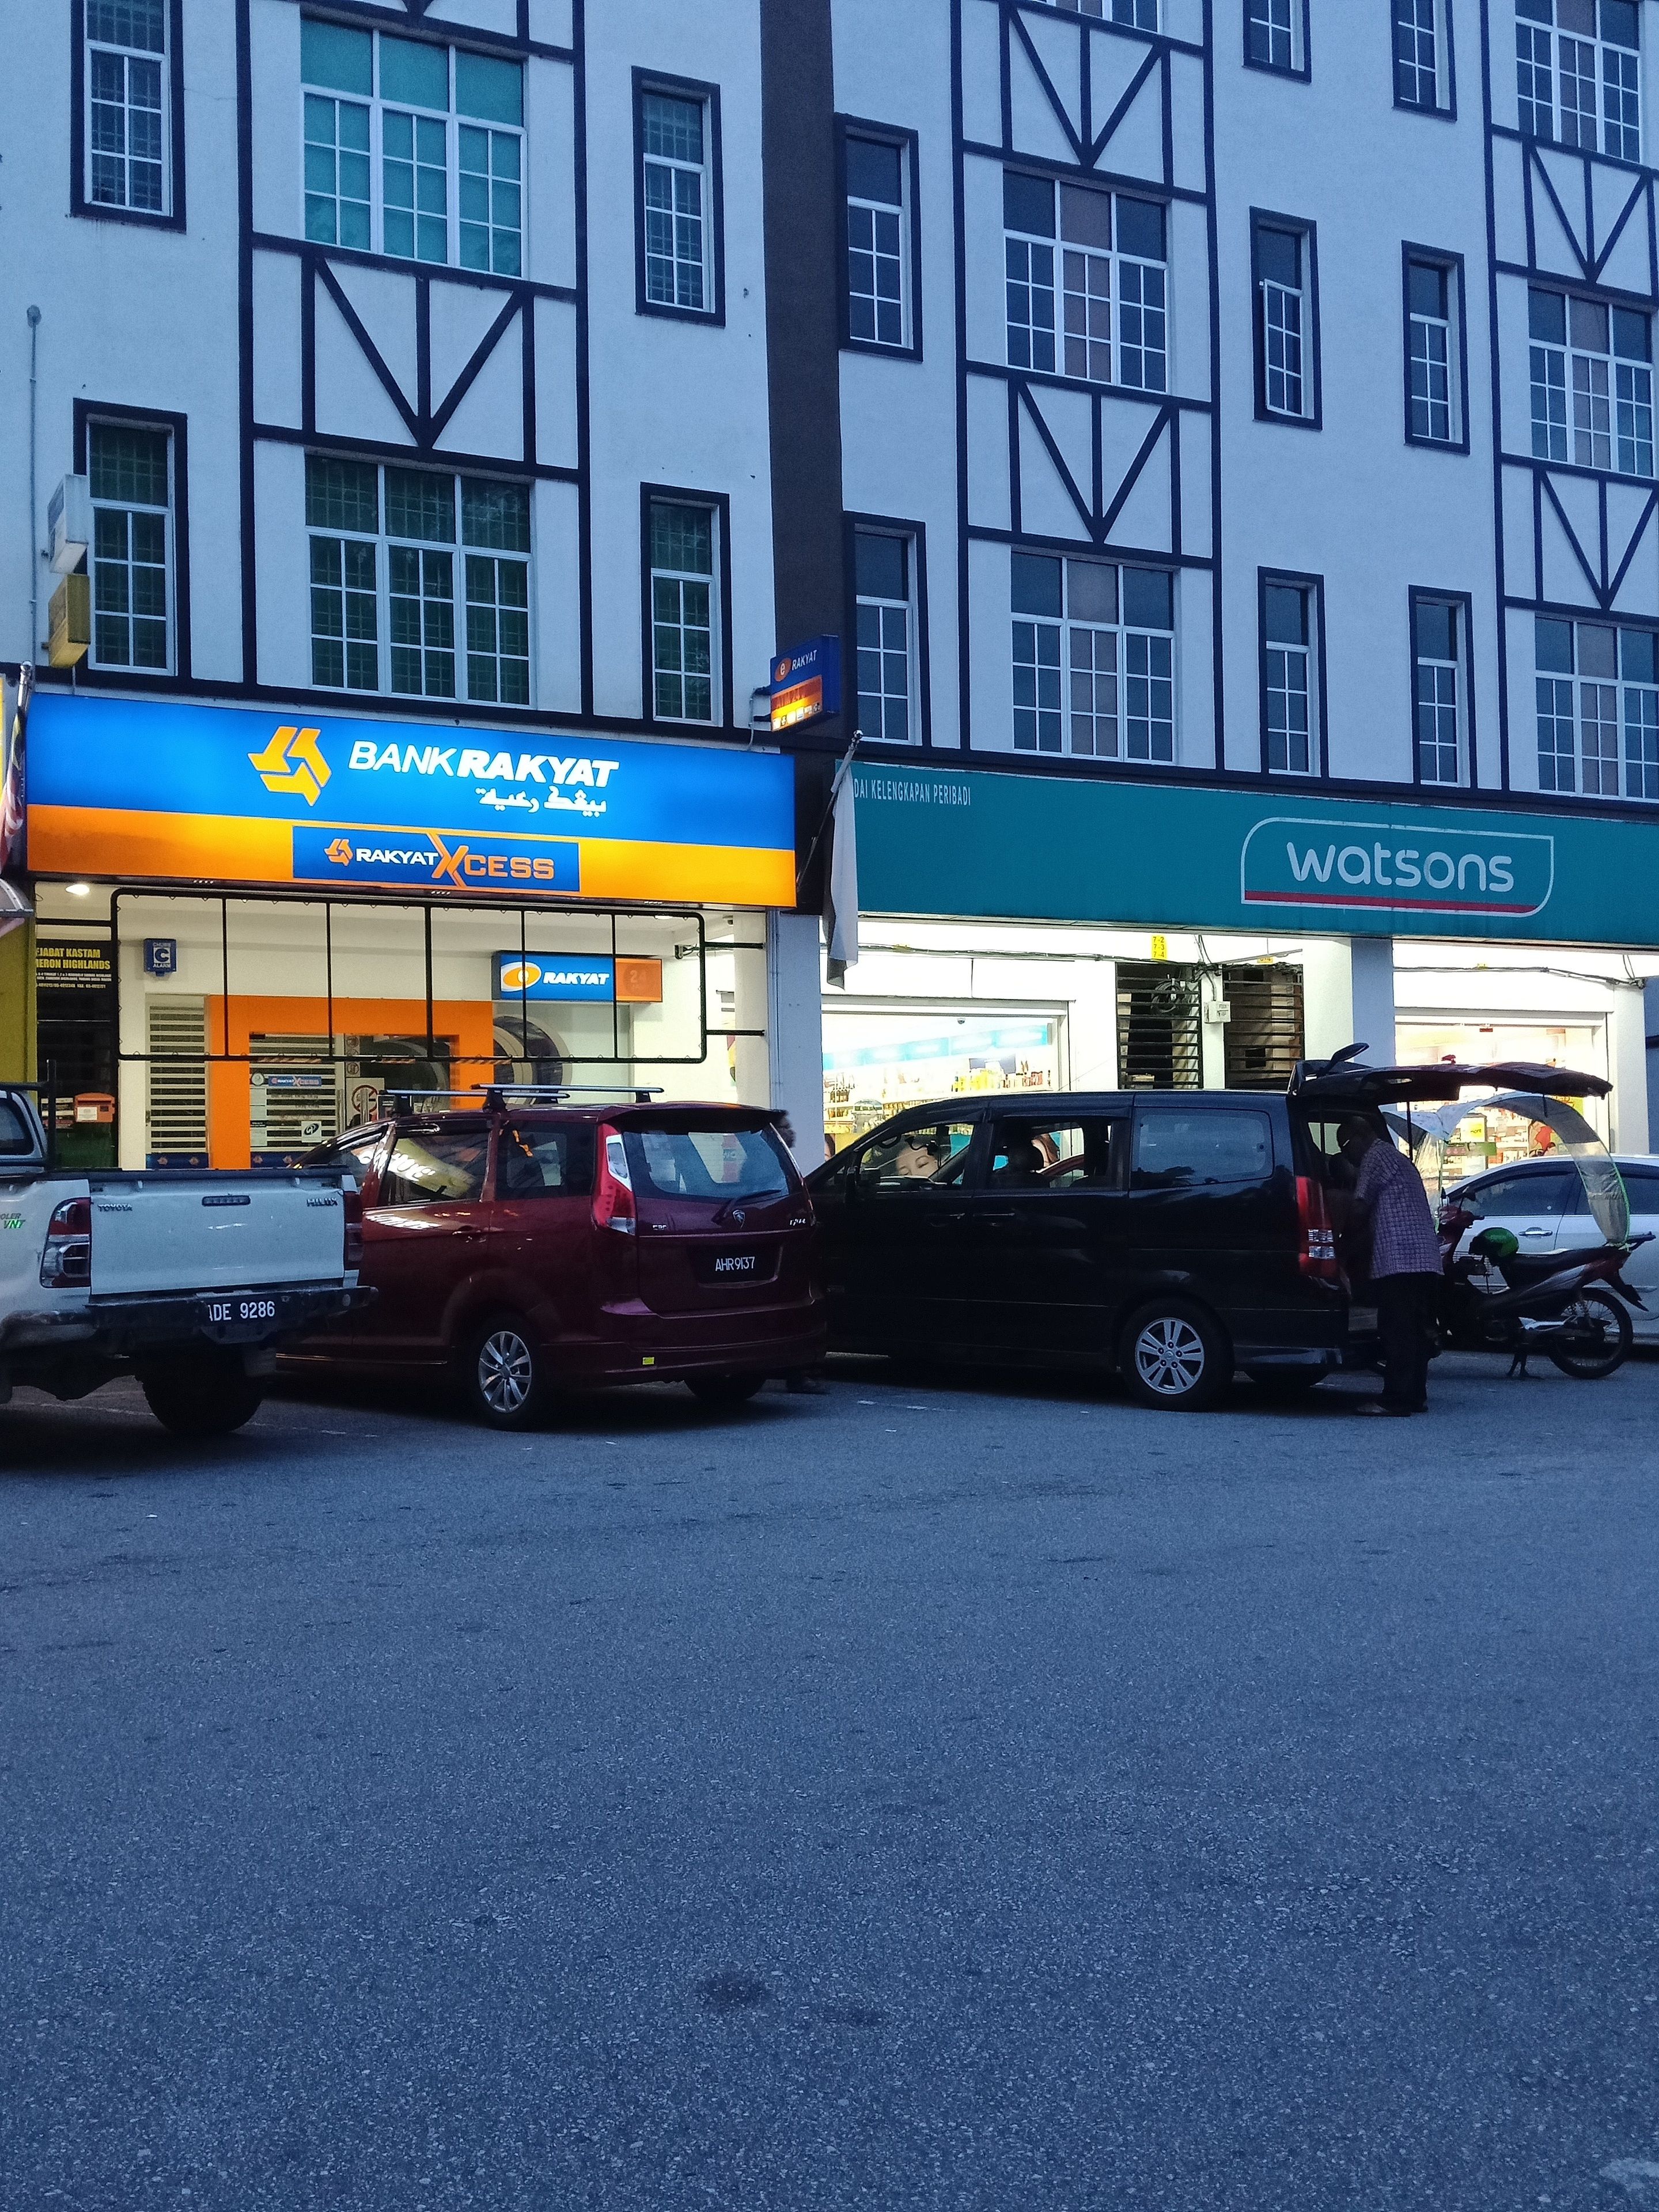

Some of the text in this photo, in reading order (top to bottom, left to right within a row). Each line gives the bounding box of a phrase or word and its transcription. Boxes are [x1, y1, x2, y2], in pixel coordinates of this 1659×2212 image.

[791, 649, 817, 671] RAKYAT
[348, 740, 620, 787] BANK RAKYAT
[871, 779, 930, 802] KELENGKAPAN
[933, 784, 971, 805] PERIBADI
[66, 948, 100, 958] KASTAM
[155, 948, 169, 963] C
[63, 959, 111, 969] HIGHLANDS
[543, 972, 609, 985] RAKYAT
[97, 1203, 132, 1212] TOYOTA
[306, 1198, 338, 1207] HILUX
[240, 1301, 275, 1319] 9286
